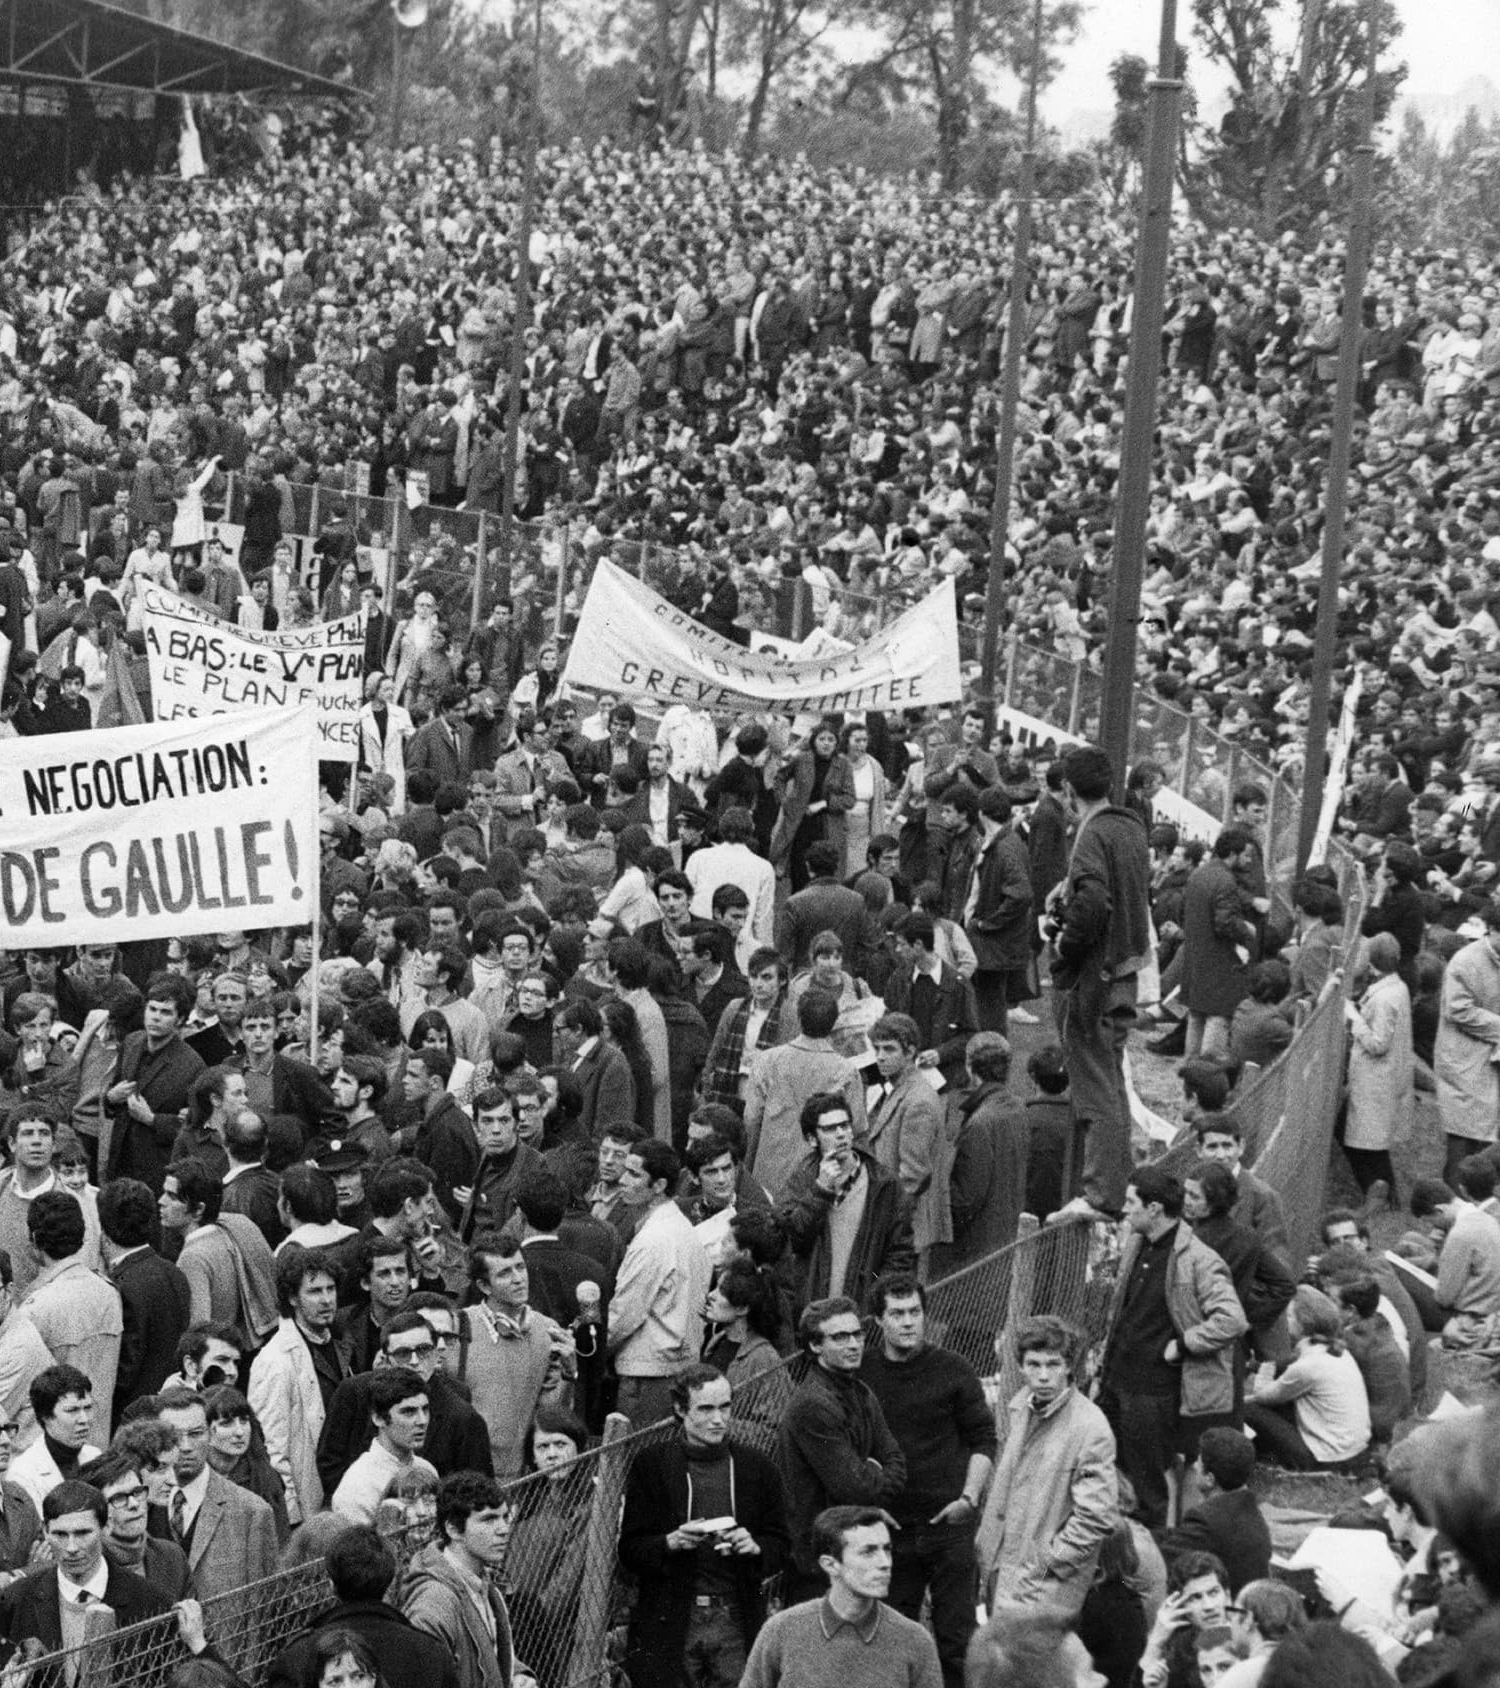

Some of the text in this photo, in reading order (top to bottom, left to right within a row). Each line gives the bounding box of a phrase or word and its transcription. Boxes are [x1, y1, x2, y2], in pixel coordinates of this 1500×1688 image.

[147, 626, 161, 656] A
[318, 653, 363, 683] PLAN
[328, 615, 364, 644] Phil
[163, 666, 188, 686] LE
[203, 673, 287, 706] PLAN
[621, 661, 922, 712] GREVE ILLIMITEE
[23, 740, 268, 816] NEGOCIATION:
[0, 847, 66, 926] DE
